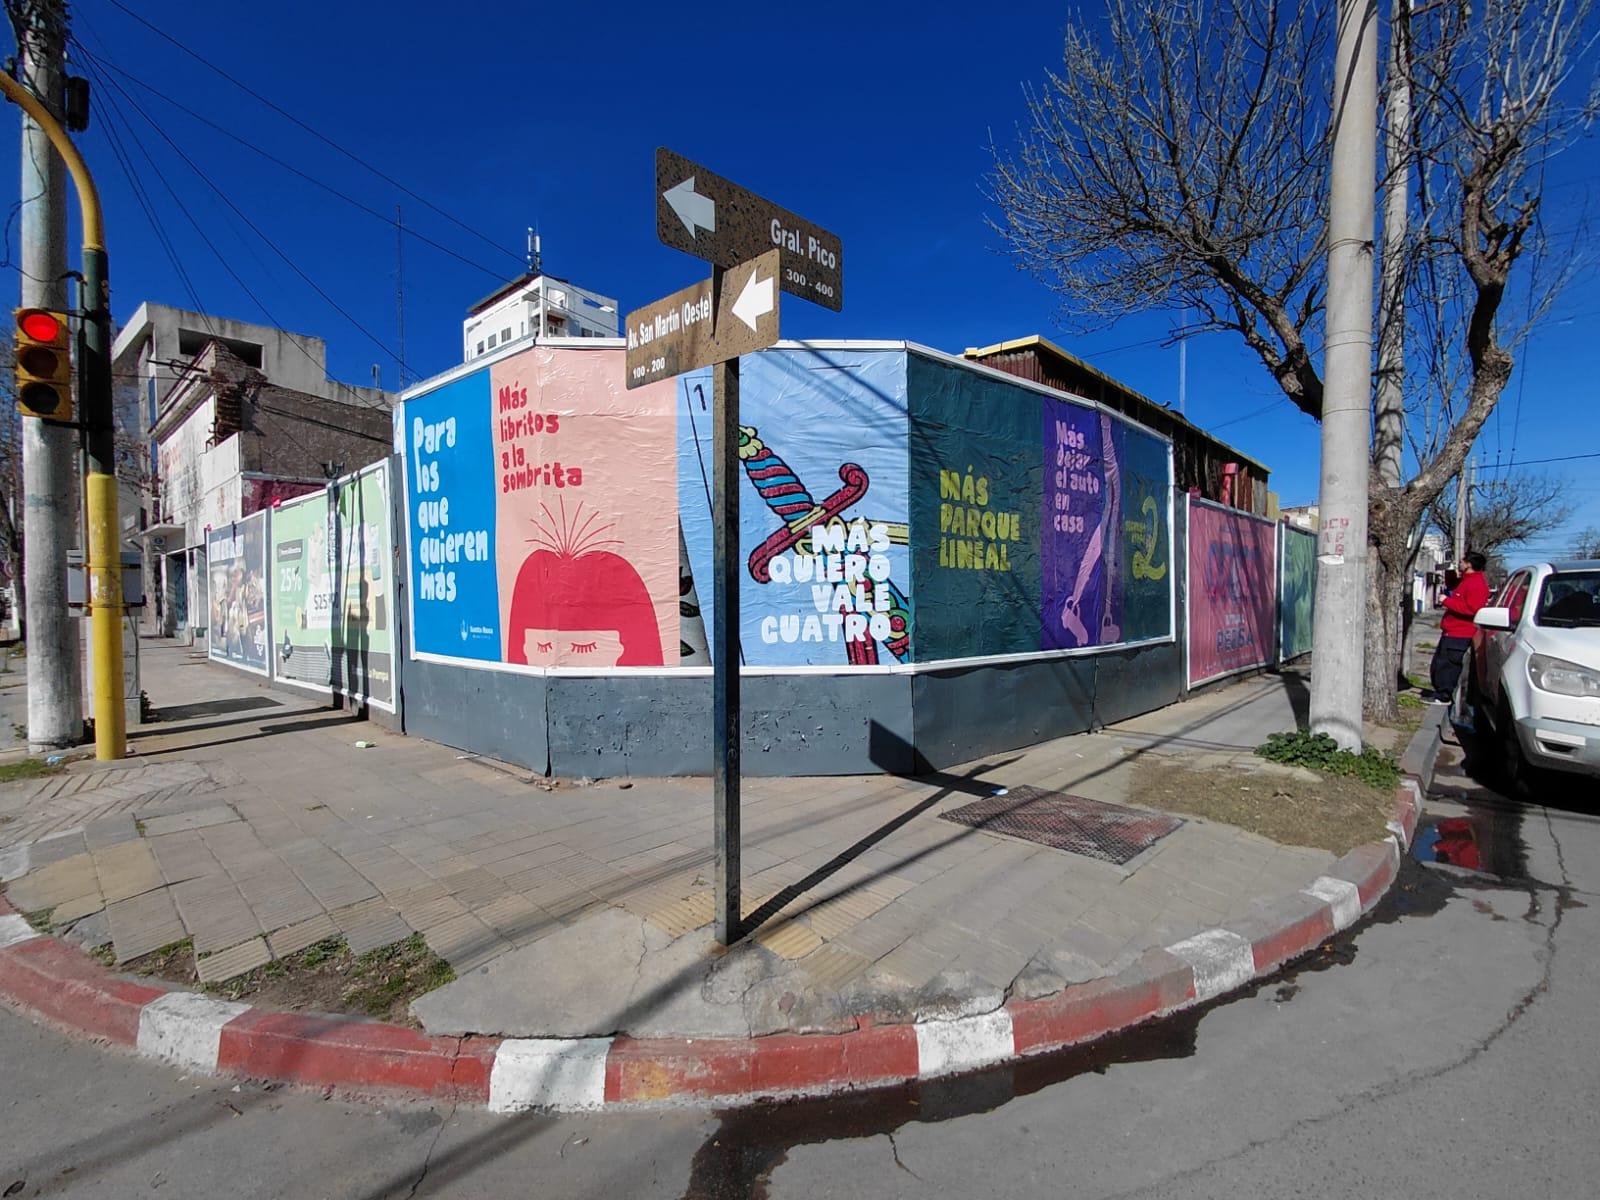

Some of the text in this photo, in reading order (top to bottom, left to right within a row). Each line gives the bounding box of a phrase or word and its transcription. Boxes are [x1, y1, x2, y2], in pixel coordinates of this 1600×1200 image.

[770, 218, 836, 270] Gral. Pico
[786, 268, 806, 287] 300
[815, 281, 834, 298] 400
[628, 328, 639, 351] Av.
[639, 322, 654, 346] San
[681, 291, 712, 334] (Oeste)
[632, 365, 645, 379] 100
[651, 357, 666, 373] 200
[499, 381, 527, 414] Más
[414, 416, 456, 454] Para
[500, 410, 559, 443] libritos
[1056, 420, 1085, 450] Más
[502, 443, 525, 470] a la
[1057, 444, 1090, 472] dejar
[415, 455, 440, 494] los
[503, 462, 582, 493] sombrita
[940, 464, 988, 506] MÁS
[1056, 466, 1099, 495] el auto
[418, 496, 449, 534] que
[1055, 492, 1070, 511] en
[811, 515, 890, 552] MÁS
[940, 503, 1020, 541] PARQUE
[1054, 514, 1084, 533] casa
[419, 529, 489, 569] quieren
[940, 536, 1012, 571] LINEAL
[420, 564, 457, 603] más
[768, 554, 890, 584] QUIERO
[811, 583, 890, 613] VALE
[761, 613, 891, 644] CUATRO
